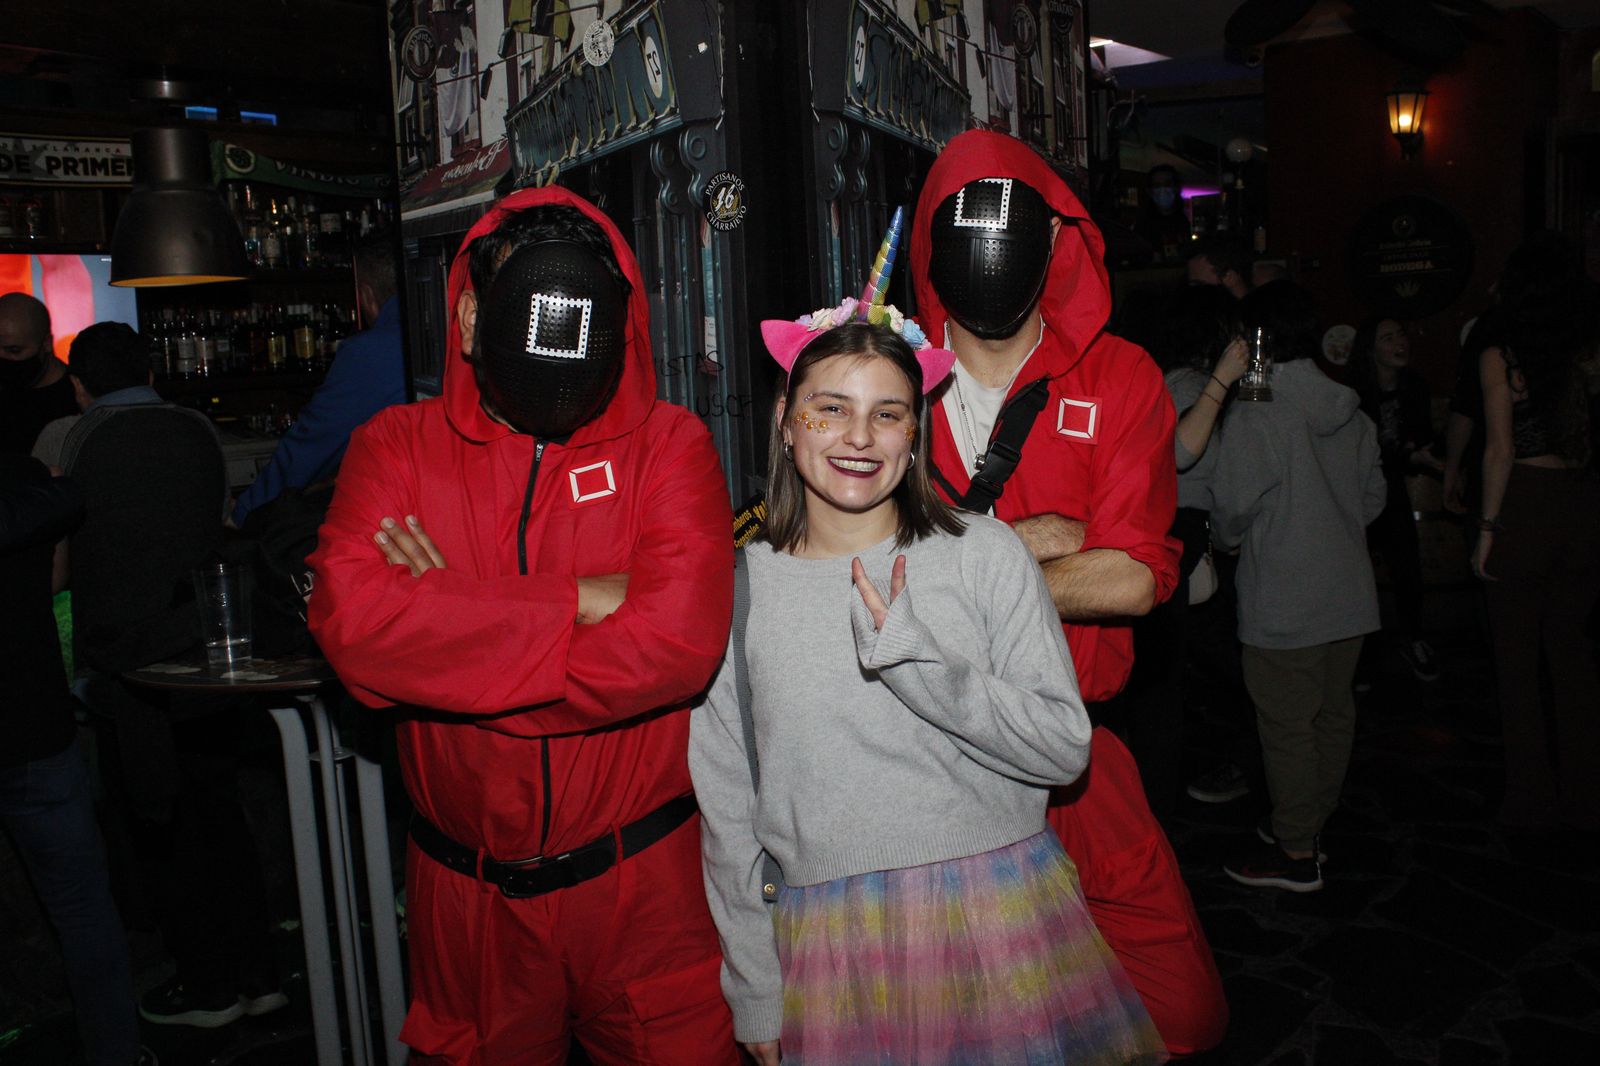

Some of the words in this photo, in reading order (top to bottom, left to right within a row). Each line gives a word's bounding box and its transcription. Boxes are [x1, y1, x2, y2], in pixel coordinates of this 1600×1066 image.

[705, 172, 745, 196] PARTISANOS
[714, 183, 736, 212] 16
[706, 205, 748, 231] CHARRAJEVO
